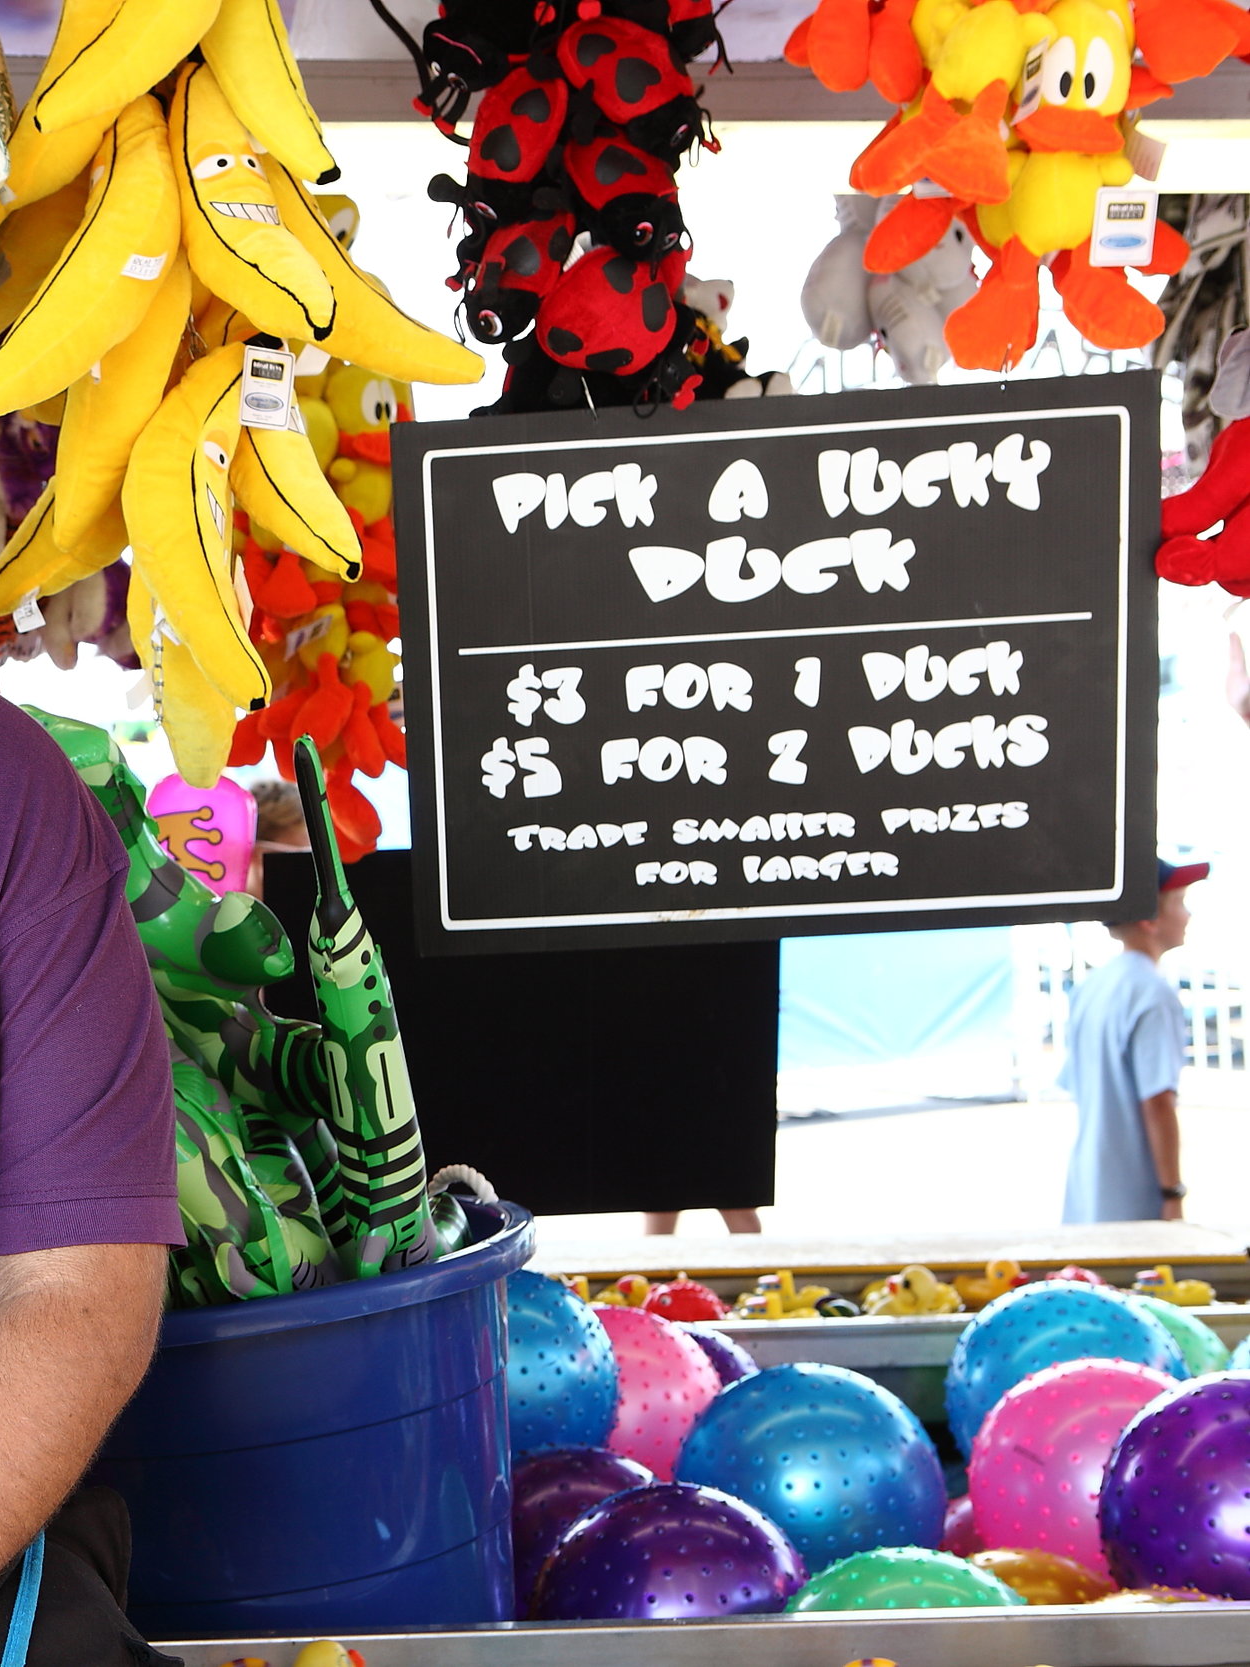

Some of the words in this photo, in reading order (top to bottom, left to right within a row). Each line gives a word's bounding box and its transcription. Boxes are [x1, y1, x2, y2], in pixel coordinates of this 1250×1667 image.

[492, 463, 657, 533] PICK
[708, 458, 769, 523] A
[818, 433, 1052, 518] LUCKY
[628, 527, 916, 603] DUCK
[506, 664, 587, 727] $3
[624, 662, 753, 713] FOR
[793, 656, 822, 707] 1
[860, 640, 1024, 702] DUCK
[480, 736, 563, 799] $5
[600, 735, 728, 786] FOR
[767, 729, 809, 785] 2
[848, 714, 1050, 775] DUCKS
[506, 821, 648, 852] TRADE
[672, 811, 857, 845] SMALLER
[880, 800, 1030, 835] PRIZES
[635, 860, 718, 887] FOR
[742, 851, 900, 884] LARGER
